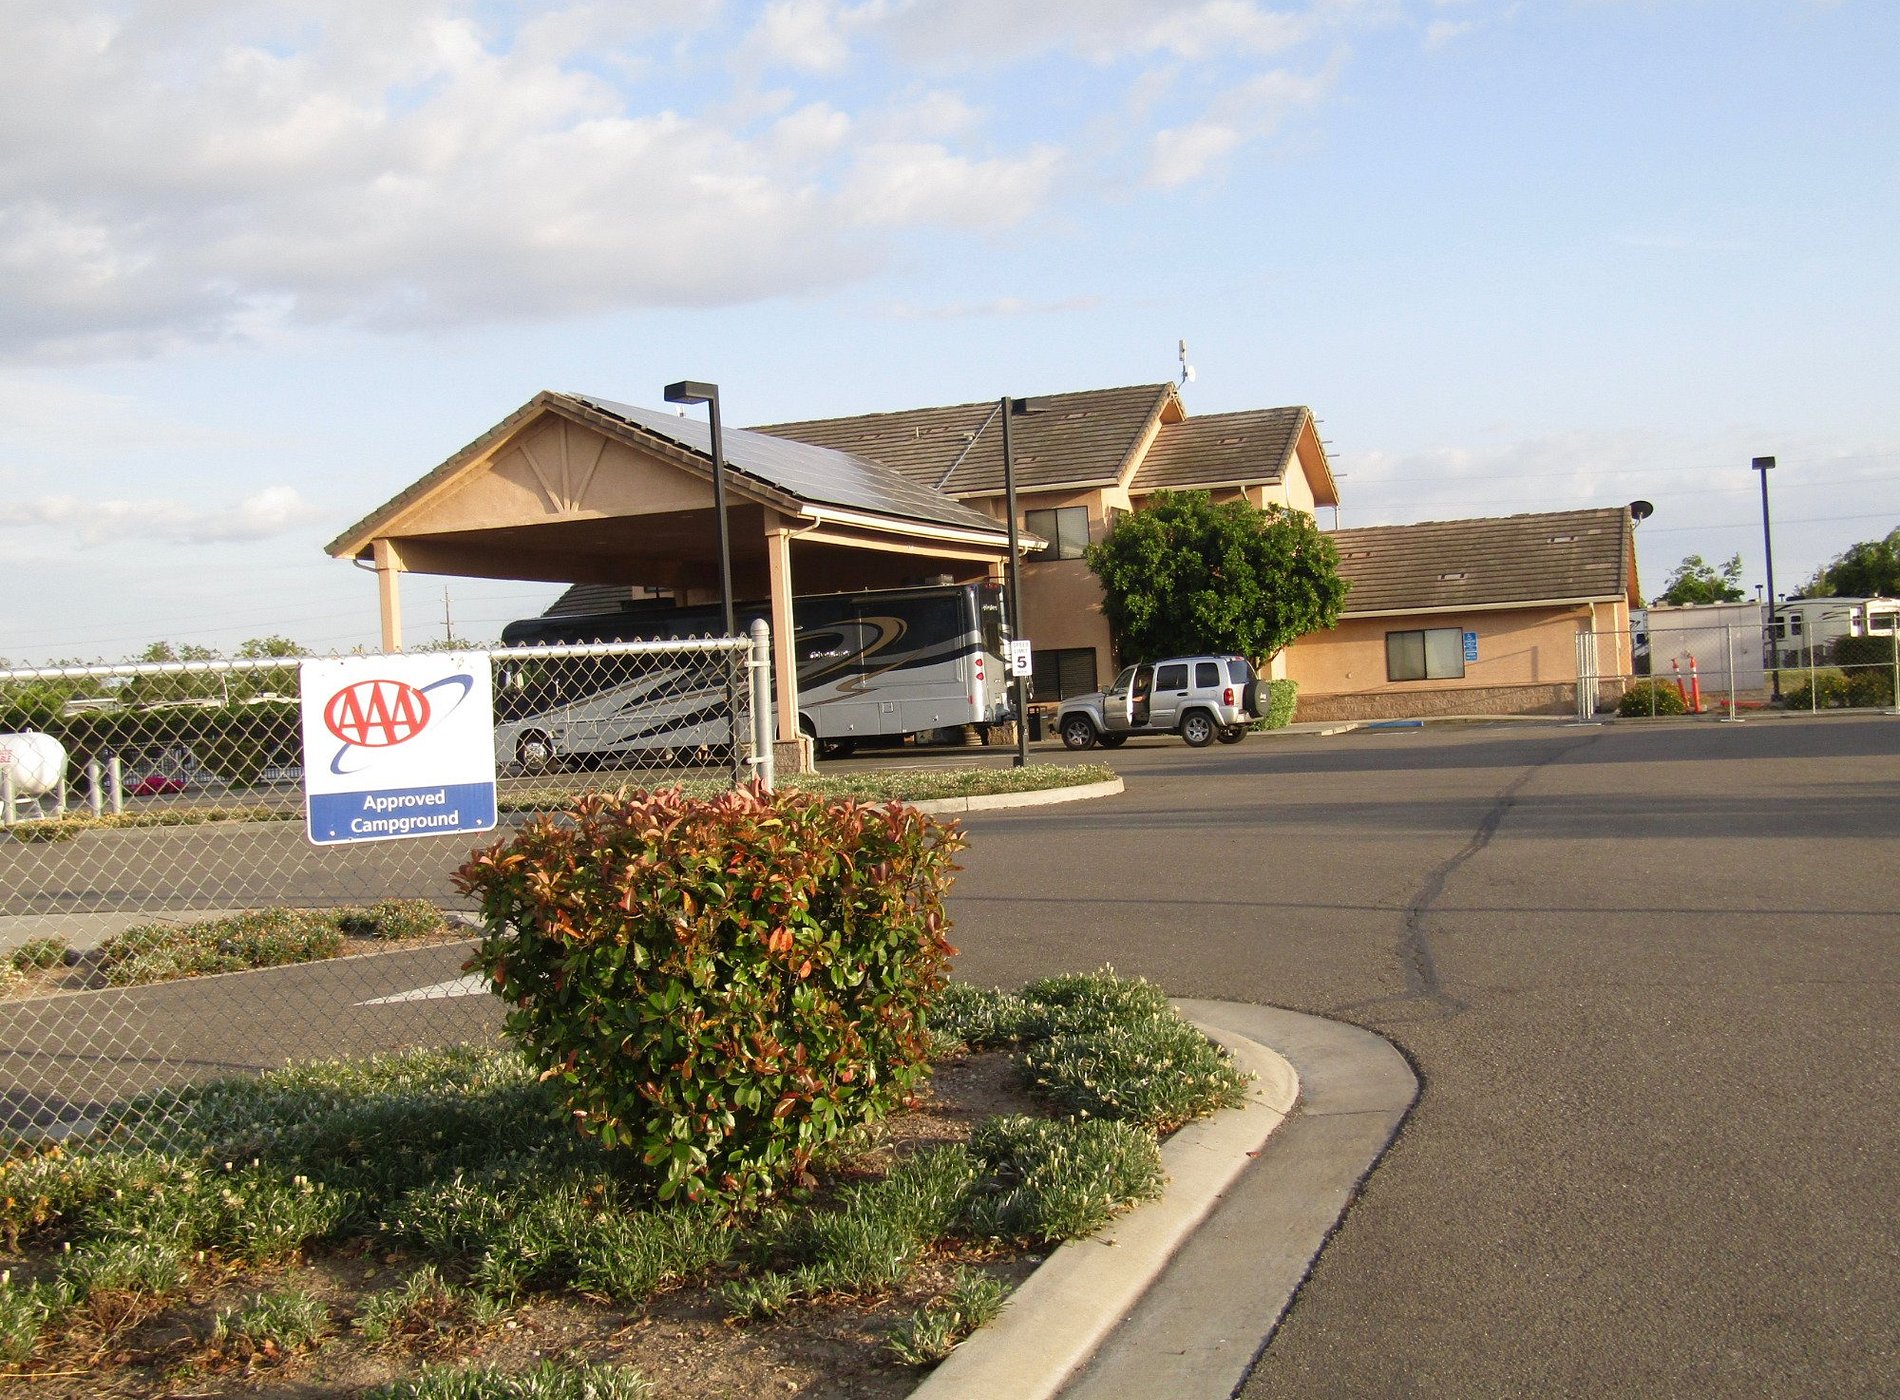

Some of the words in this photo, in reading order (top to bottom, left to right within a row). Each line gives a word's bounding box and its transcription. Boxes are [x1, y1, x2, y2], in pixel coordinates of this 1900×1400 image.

[1017, 656, 1027, 668] 5
[337, 680, 420, 745] AAA
[363, 789, 446, 812] Approved
[351, 810, 459, 834] Campground
